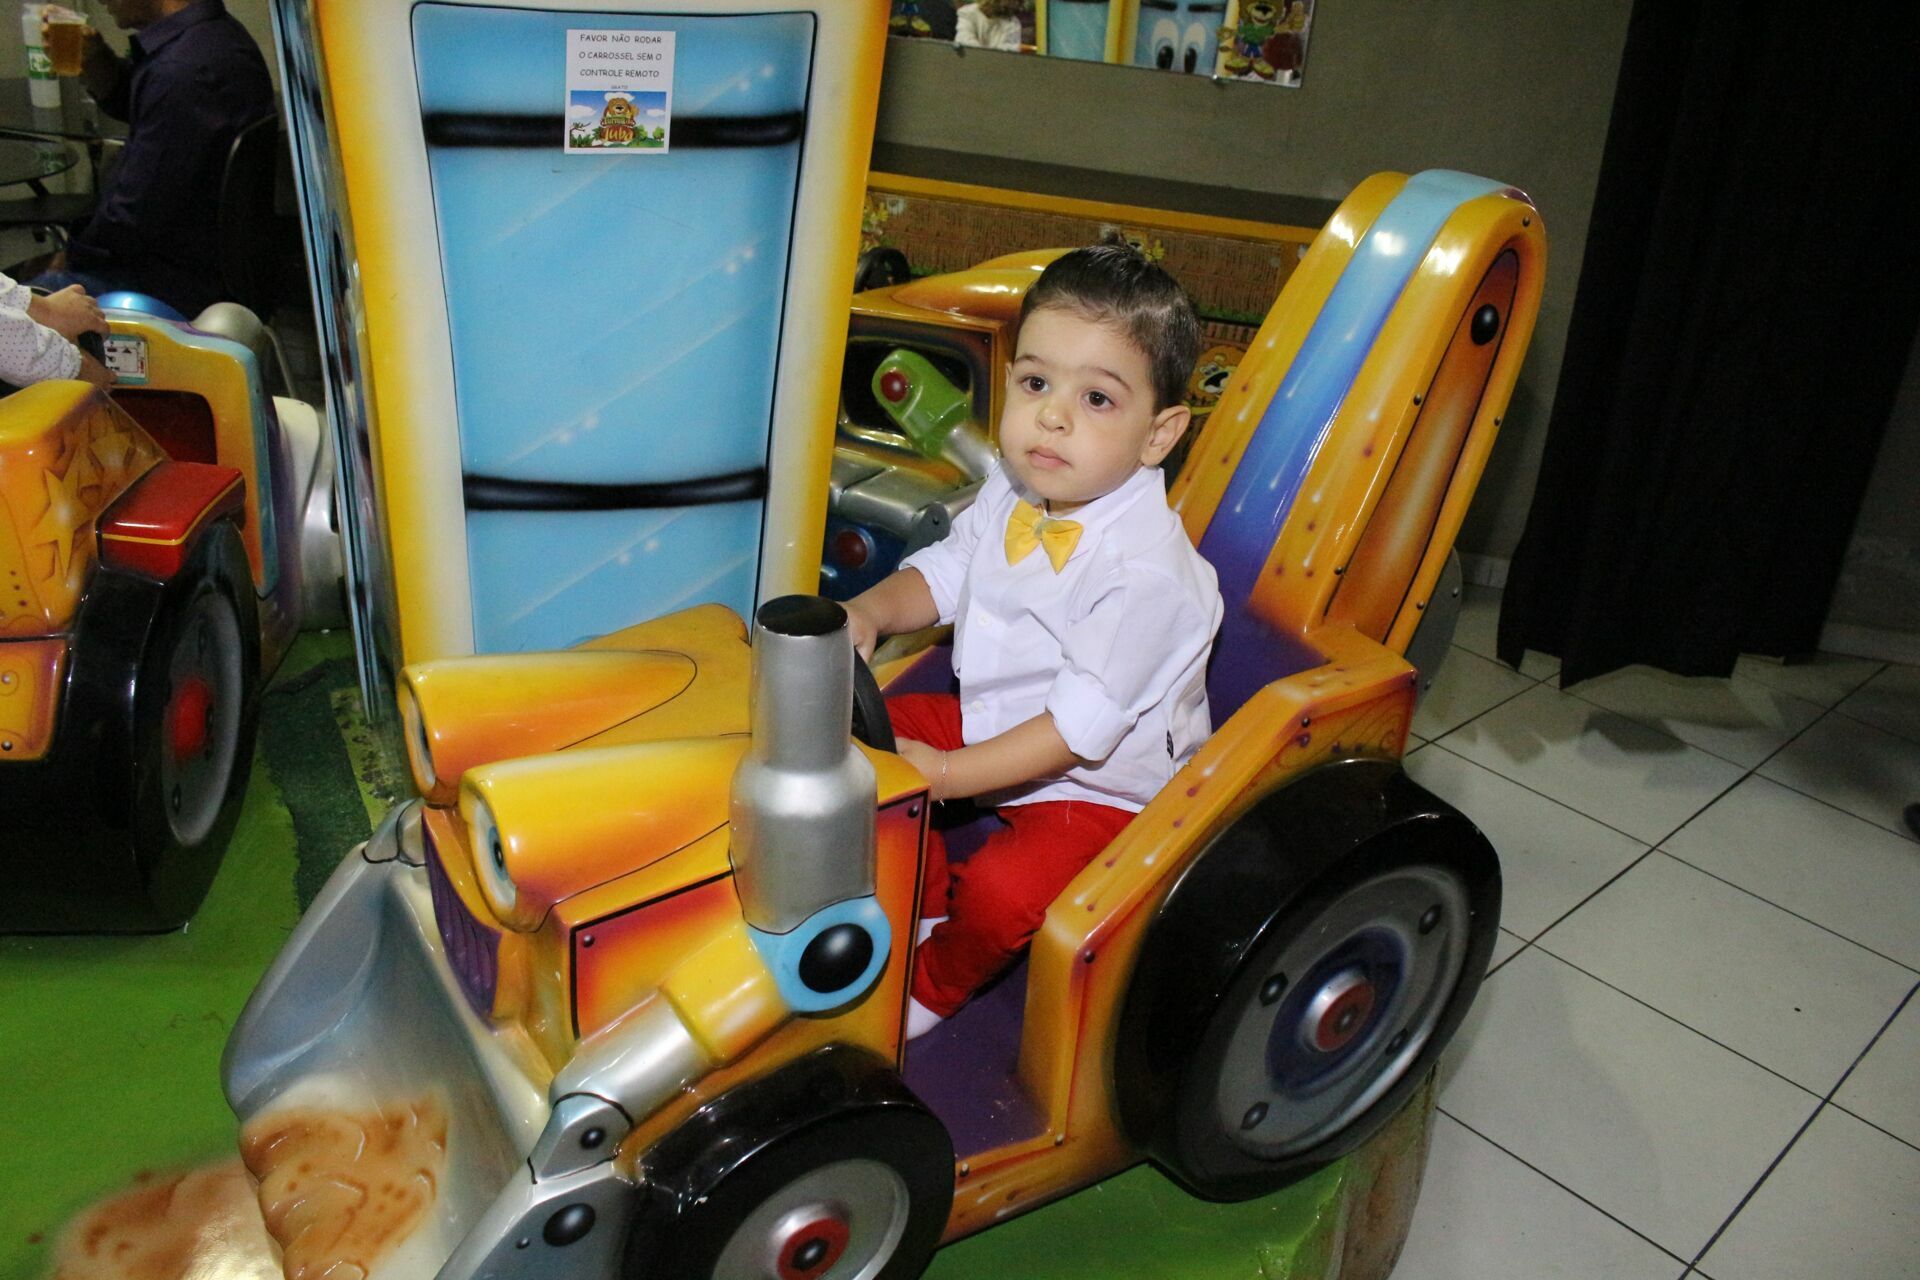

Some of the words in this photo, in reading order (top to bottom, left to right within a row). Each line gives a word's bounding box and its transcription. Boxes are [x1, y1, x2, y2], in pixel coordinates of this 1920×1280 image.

[580, 34, 607, 42] FAVOR
[612, 34, 630, 43] NÃO
[635, 35, 662, 44] RODAR
[578, 51, 586, 59] O
[587, 52, 634, 60] CARROSSEL
[637, 53, 653, 61] SEM
[655, 53, 662, 61] O
[580, 69, 623, 77] CONTROLE
[625, 70, 660, 78] REMOTO
